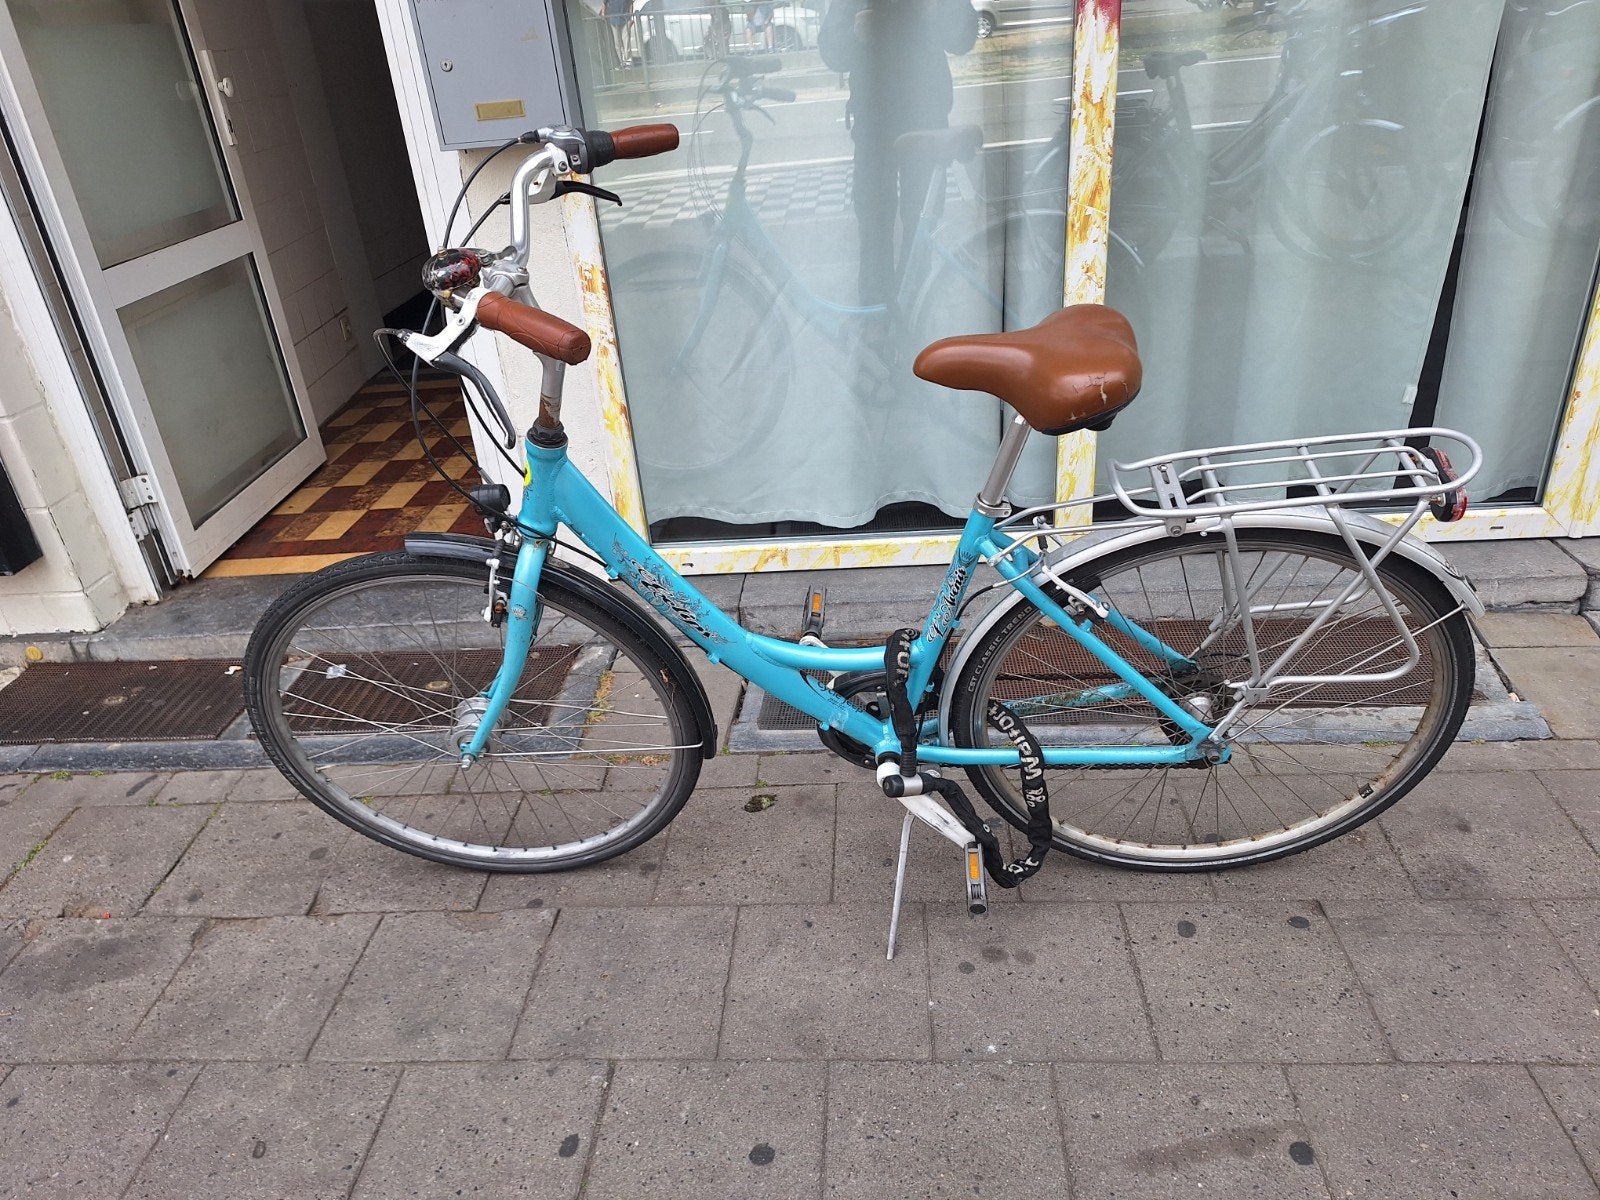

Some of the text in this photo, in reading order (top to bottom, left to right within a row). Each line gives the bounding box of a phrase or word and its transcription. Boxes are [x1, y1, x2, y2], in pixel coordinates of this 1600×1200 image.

[926, 567, 966, 642] L'Avenir
[967, 605, 1033, 693] CST CLASSIC TREND
